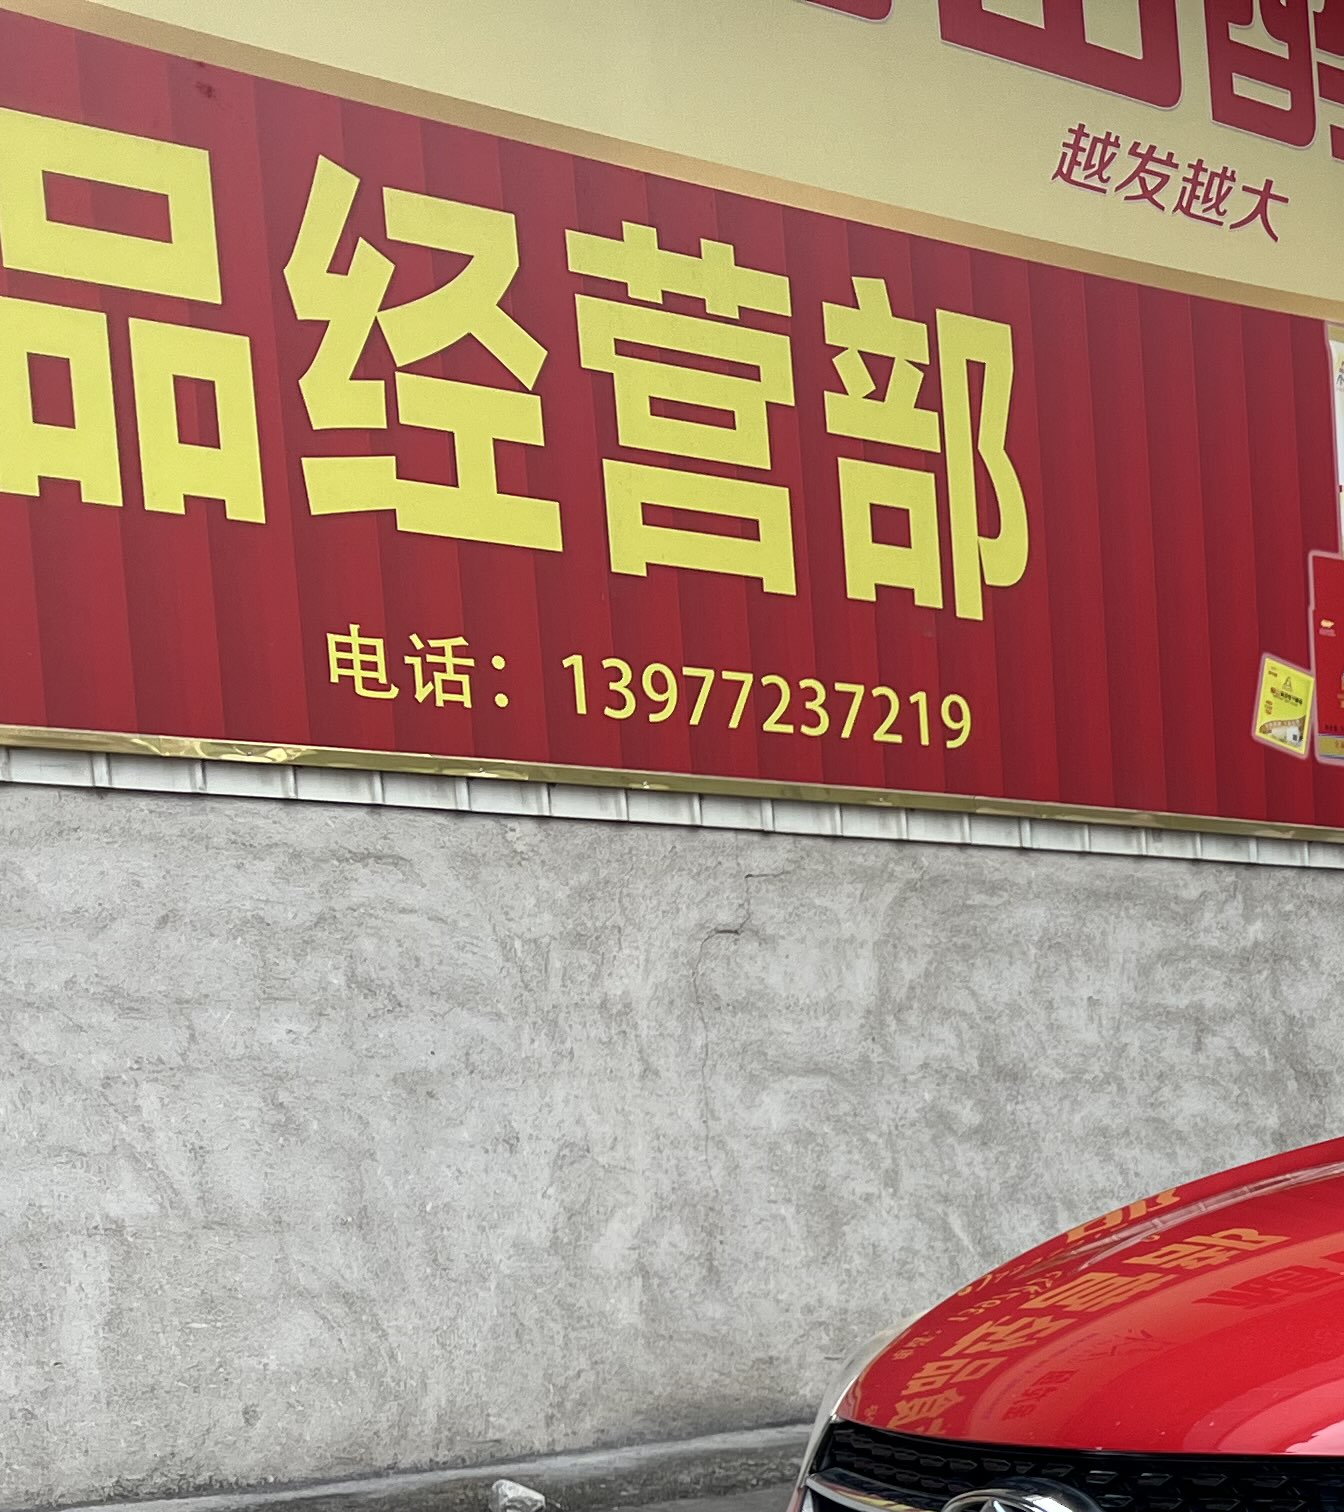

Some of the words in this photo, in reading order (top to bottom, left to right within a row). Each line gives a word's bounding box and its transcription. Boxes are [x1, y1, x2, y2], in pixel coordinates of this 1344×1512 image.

[1051, 121, 1290, 243] 越发越大
[0, 106, 1029, 621] 品经营部
[561, 653, 972, 749] 13977237219
